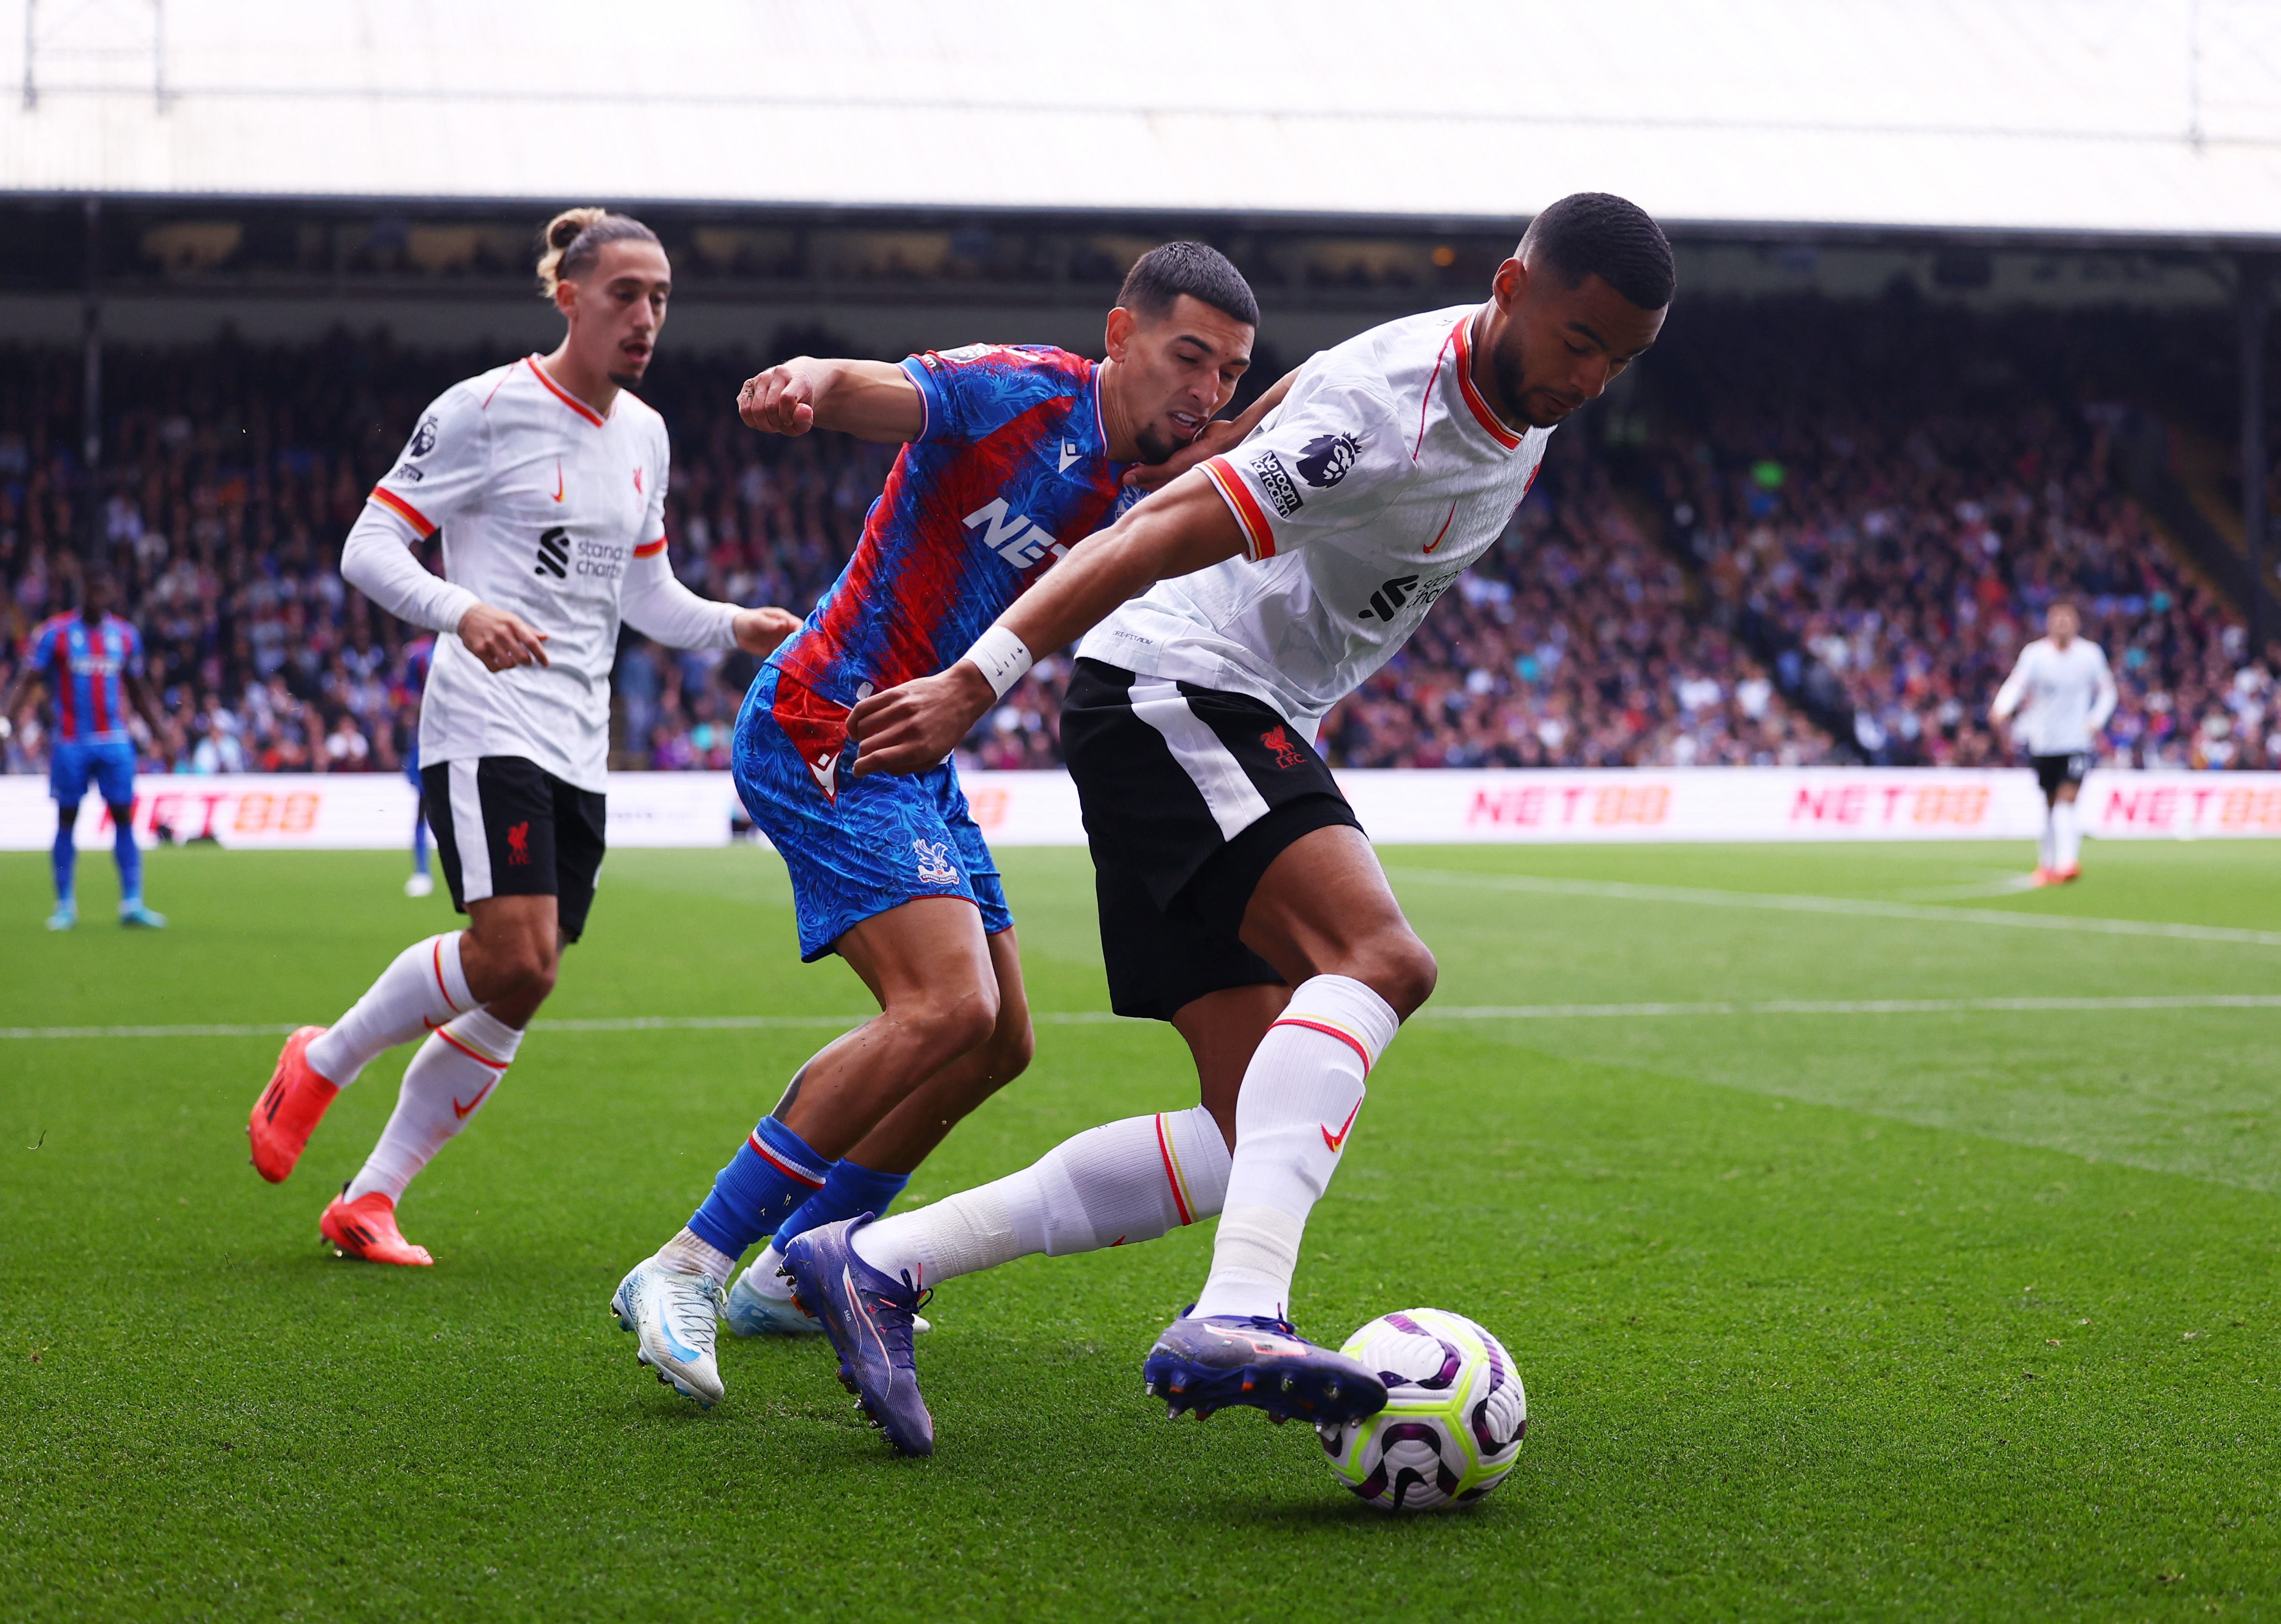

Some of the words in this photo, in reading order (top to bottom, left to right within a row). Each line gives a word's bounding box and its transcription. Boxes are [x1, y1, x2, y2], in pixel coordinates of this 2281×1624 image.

[1260, 451, 1278, 471] No
[1273, 470, 1298, 506] room
[1261, 474, 1291, 519] racism
